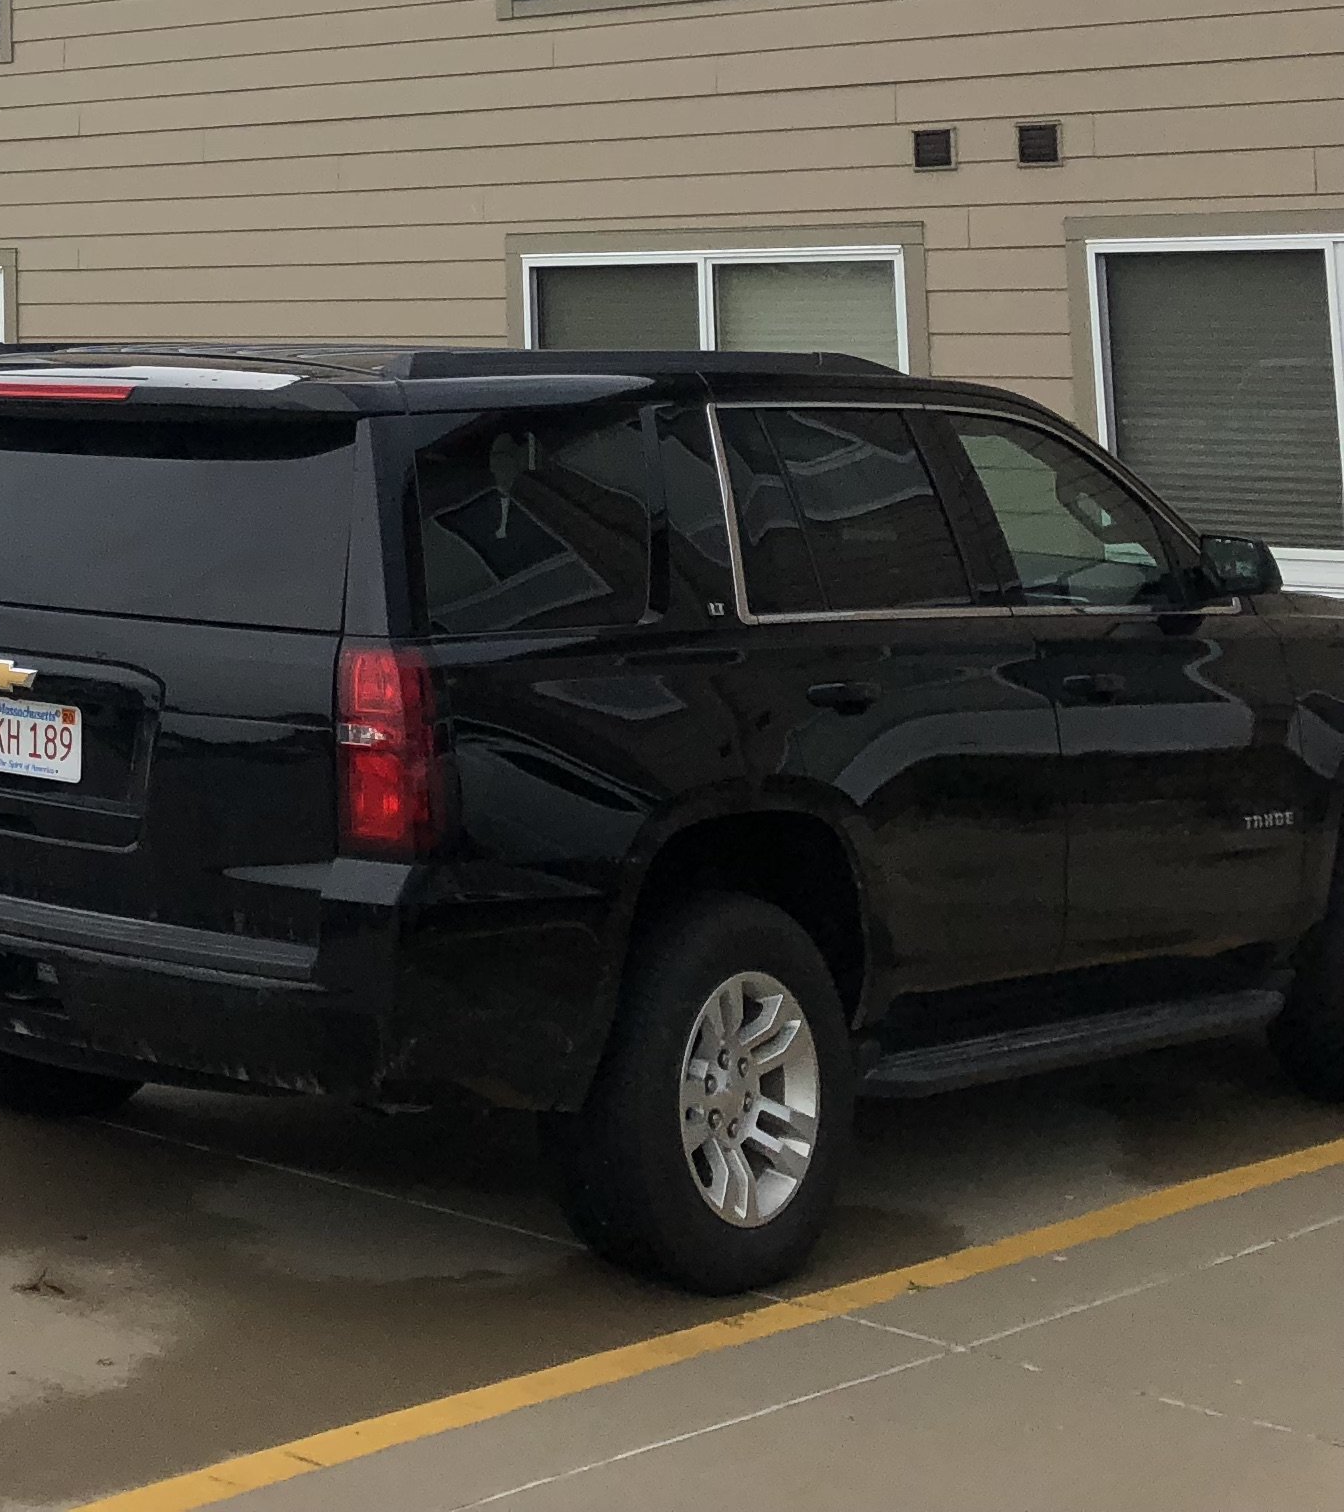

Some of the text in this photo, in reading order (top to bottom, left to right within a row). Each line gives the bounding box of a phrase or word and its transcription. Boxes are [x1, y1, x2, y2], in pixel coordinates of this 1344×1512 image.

[62, 711, 74, 722] 20
[28, 722, 73, 762] 189
[1245, 811, 1294, 830] TAHOE
